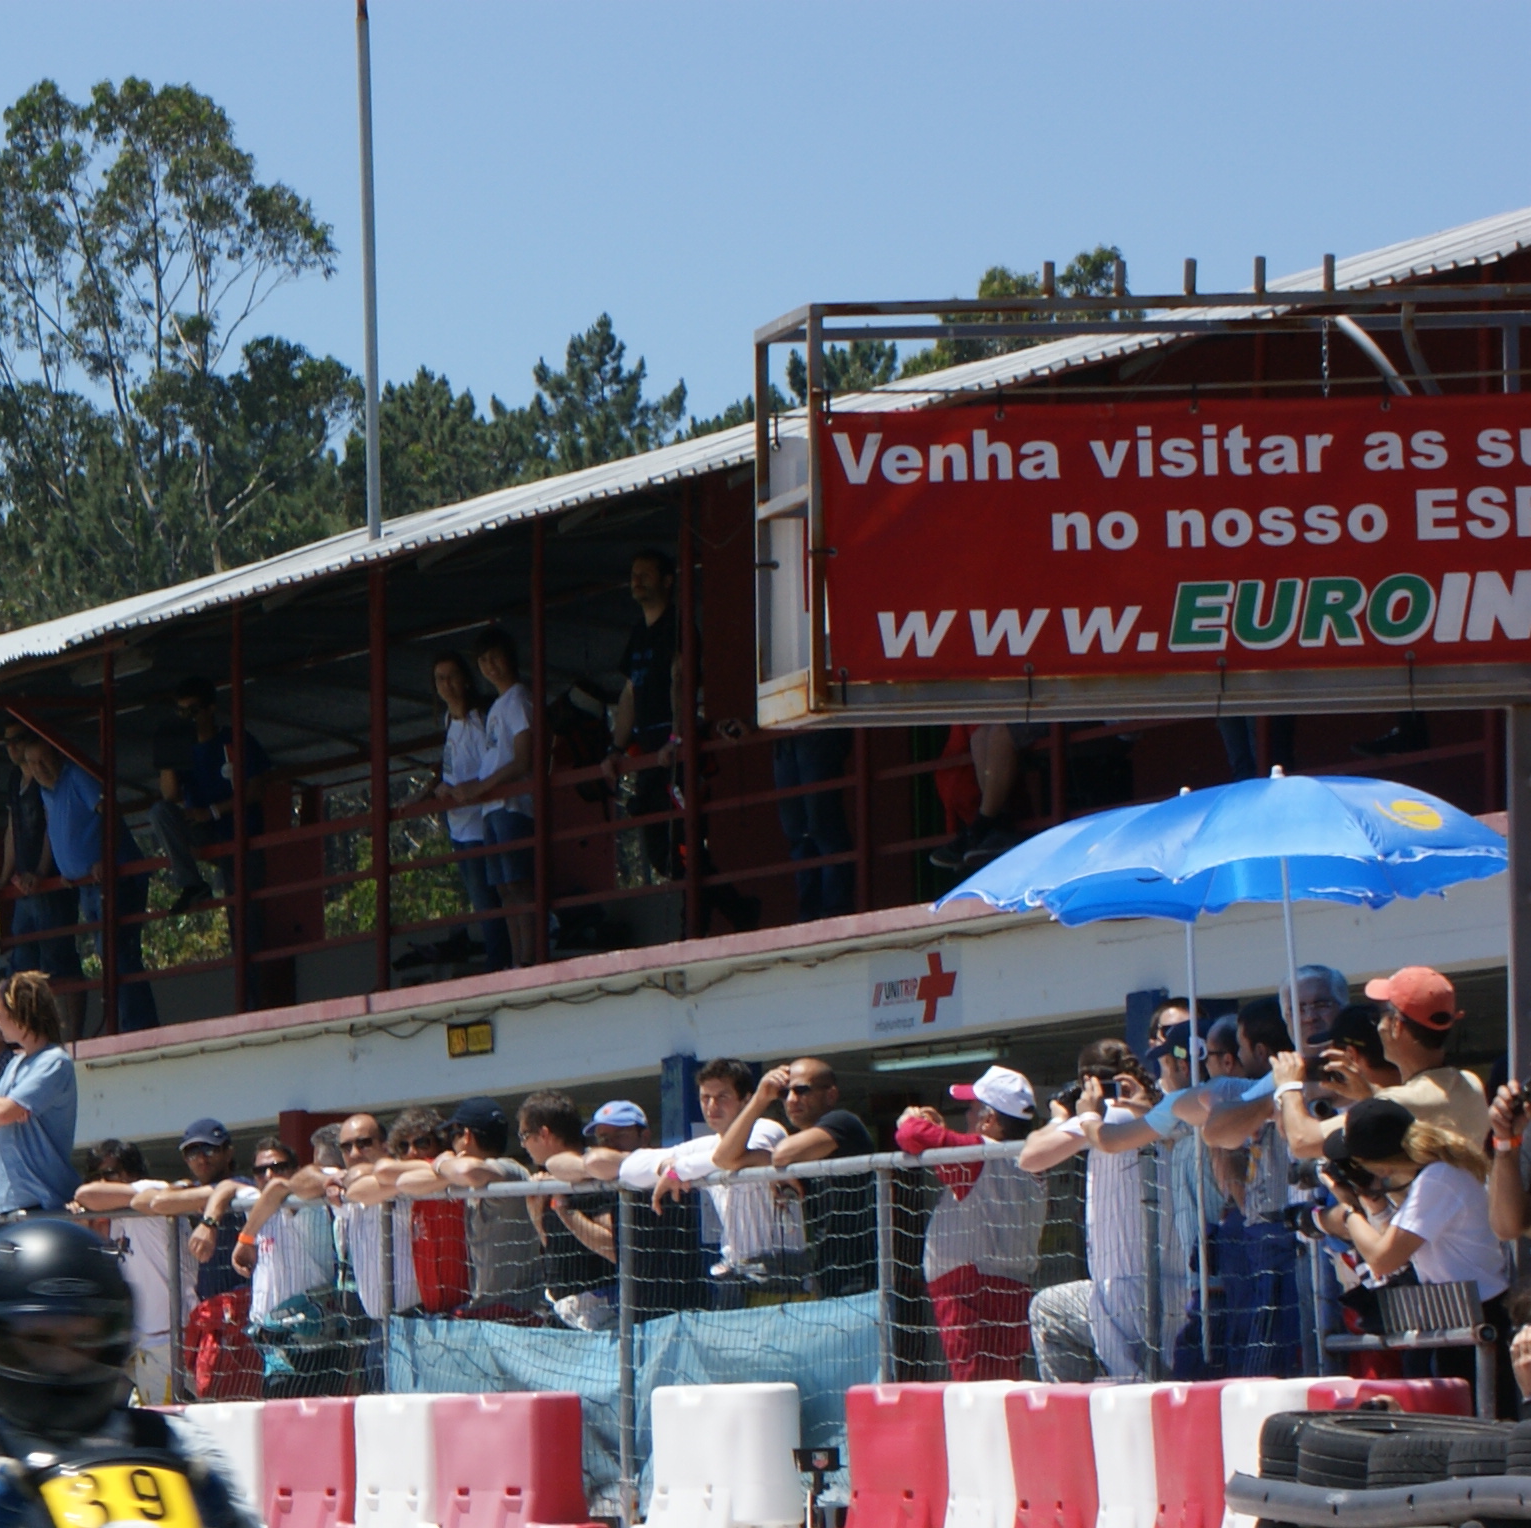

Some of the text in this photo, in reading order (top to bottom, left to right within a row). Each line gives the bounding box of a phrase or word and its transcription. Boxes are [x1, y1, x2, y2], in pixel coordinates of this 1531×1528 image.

[832, 429, 1060, 485] Venha
[1090, 425, 1333, 479] visitar
[1364, 431, 1448, 471] as
[1052, 510, 1139, 552] no
[1167, 503, 1388, 548] nosso
